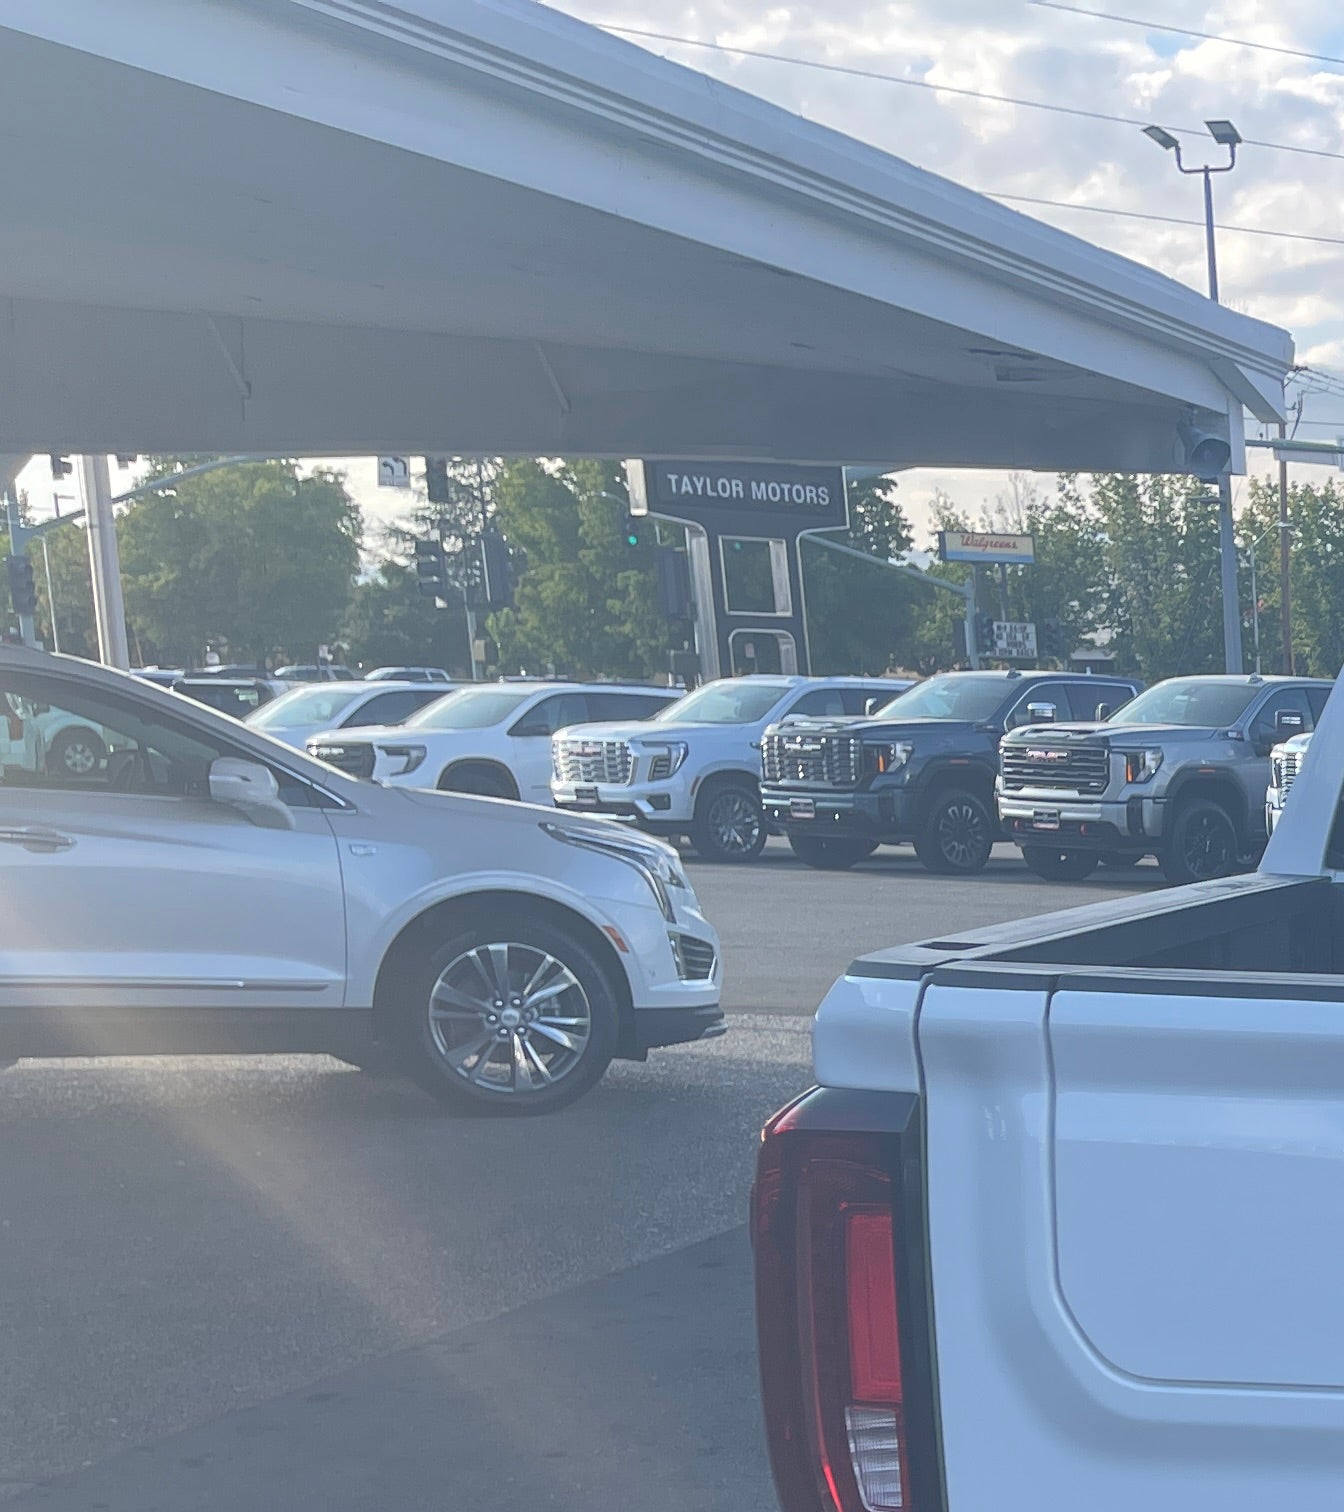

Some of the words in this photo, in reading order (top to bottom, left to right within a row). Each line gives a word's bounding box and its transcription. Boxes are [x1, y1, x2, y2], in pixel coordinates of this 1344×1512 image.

[667, 474, 744, 499] TAYLOR
[751, 481, 830, 506] MOTORS
[960, 535, 1018, 552] Walgreens
